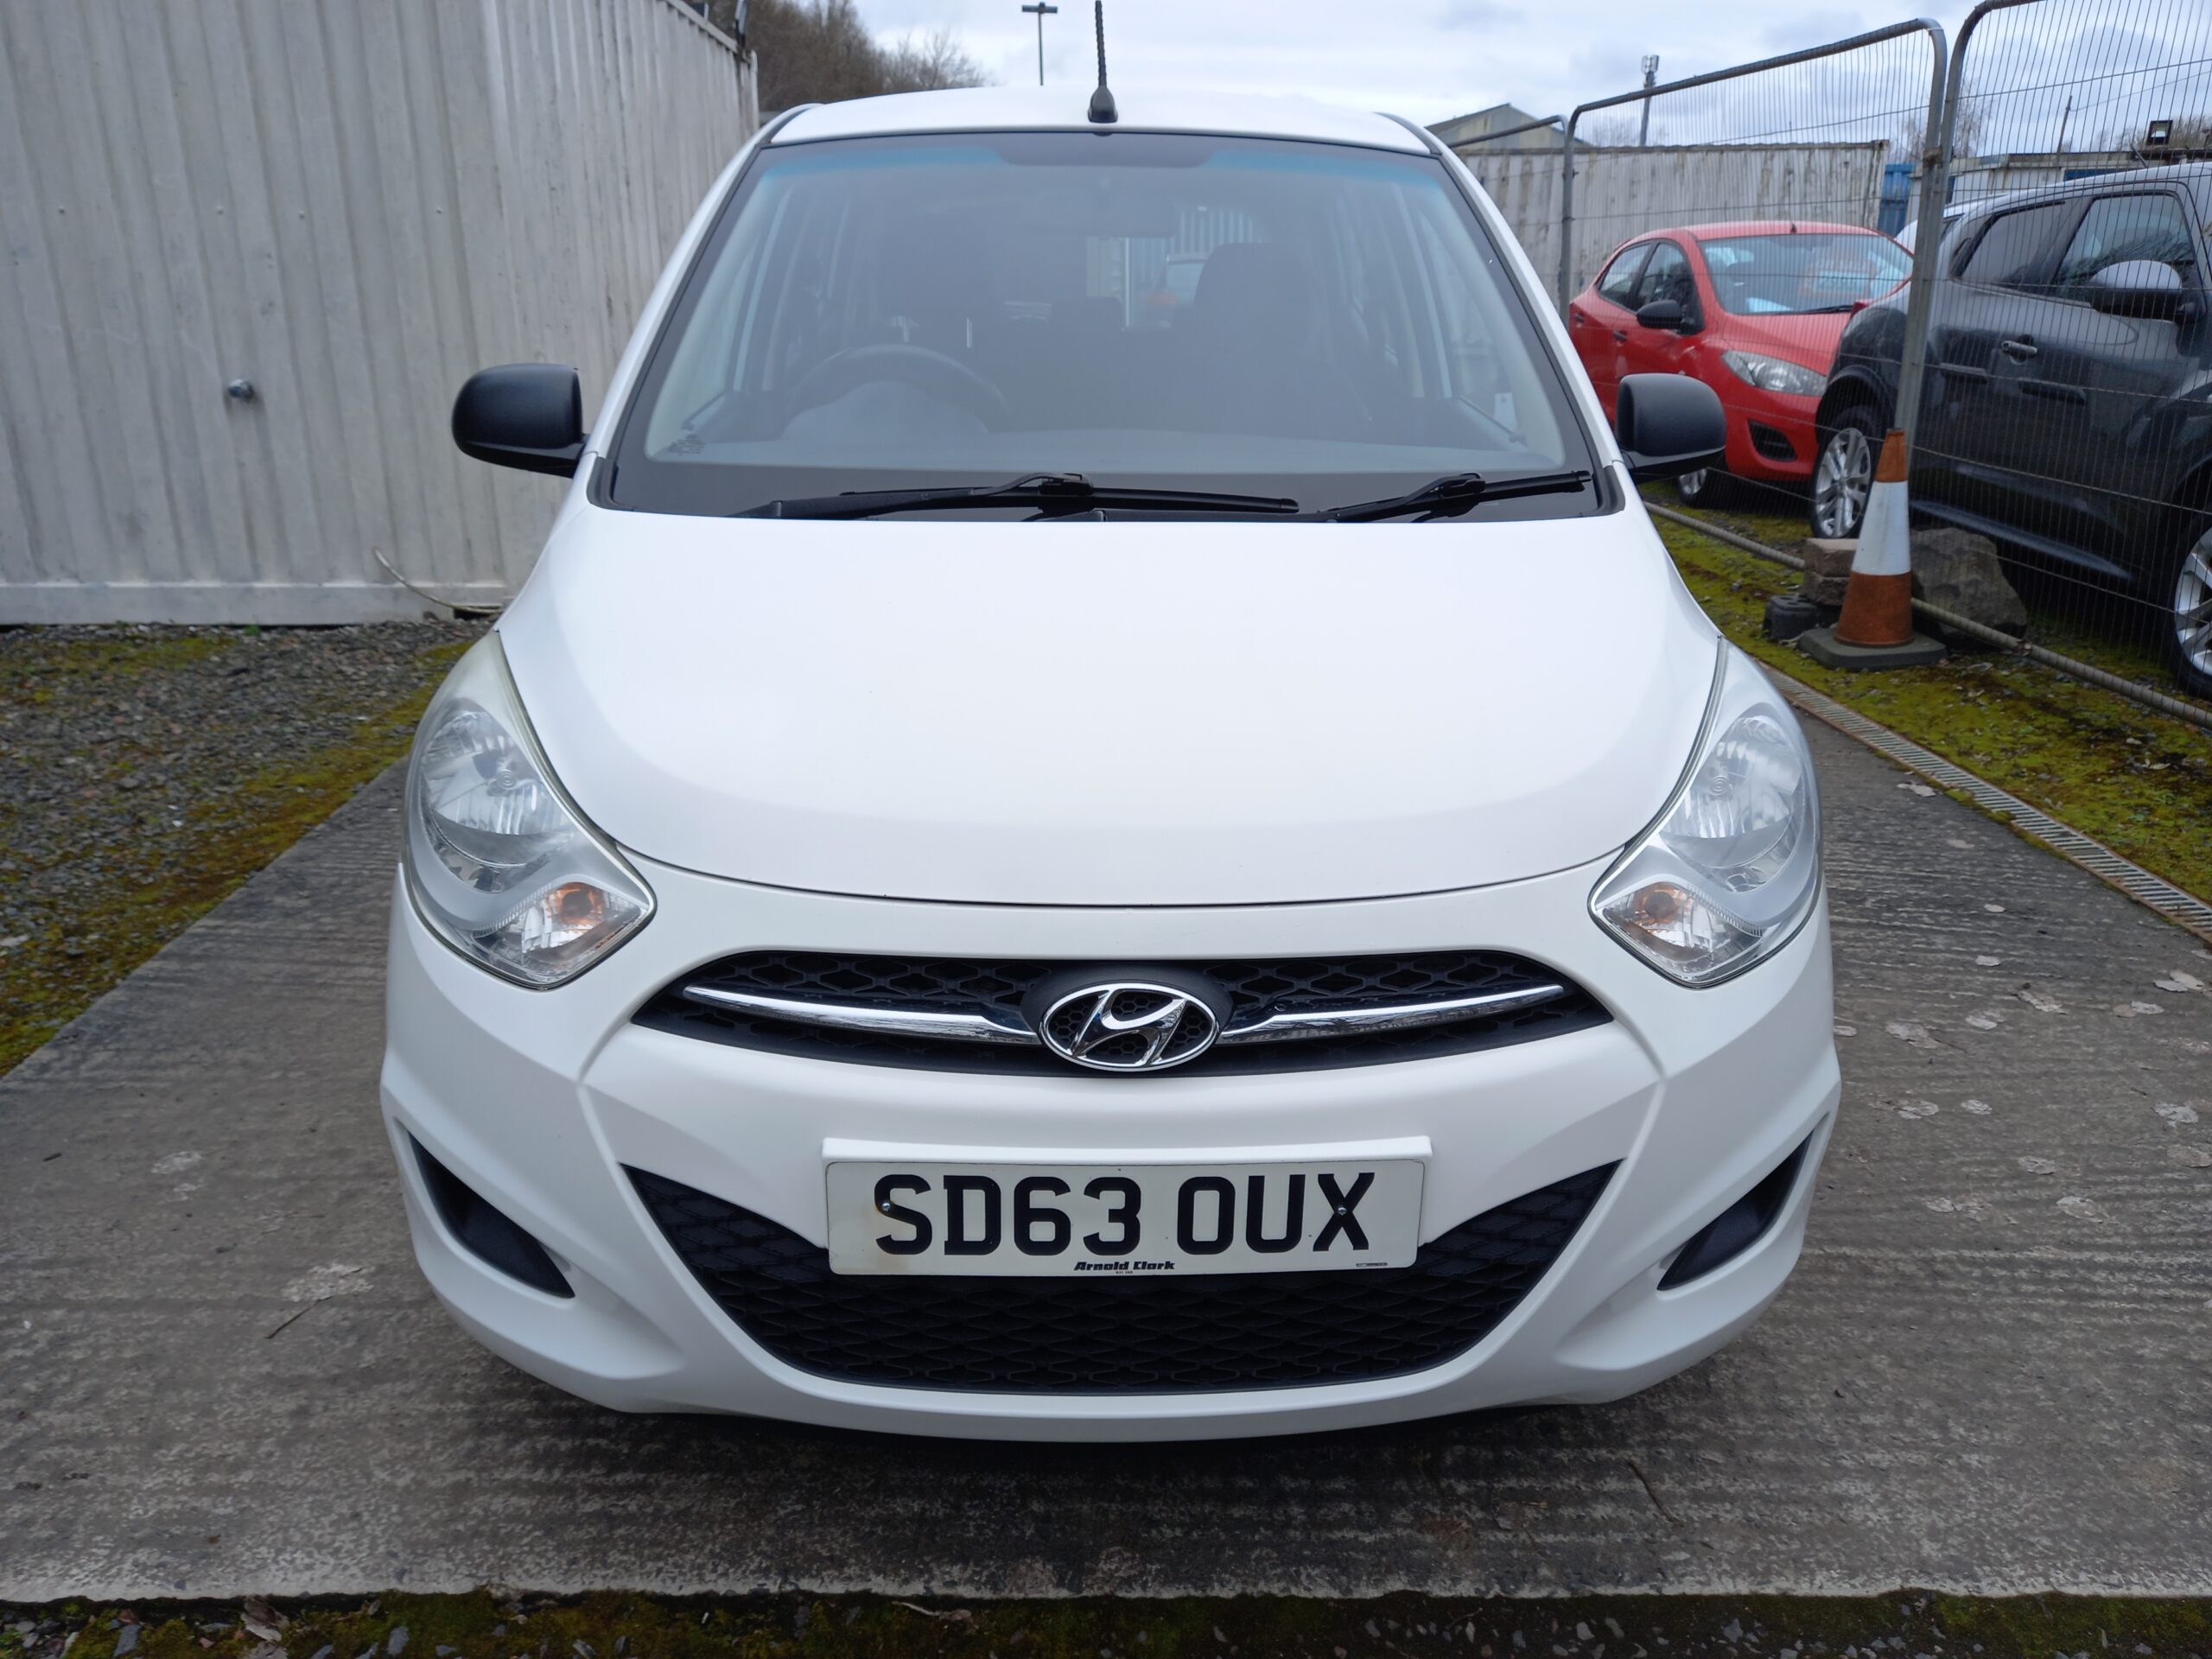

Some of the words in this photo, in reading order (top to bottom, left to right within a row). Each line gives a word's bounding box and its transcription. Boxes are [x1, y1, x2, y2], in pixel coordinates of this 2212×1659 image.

[874, 1173, 1141, 1256] SD63
[1176, 1172, 1376, 1254] OUX
[1073, 1261, 1129, 1271] Arnold
[1133, 1261, 1175, 1270] Clark
